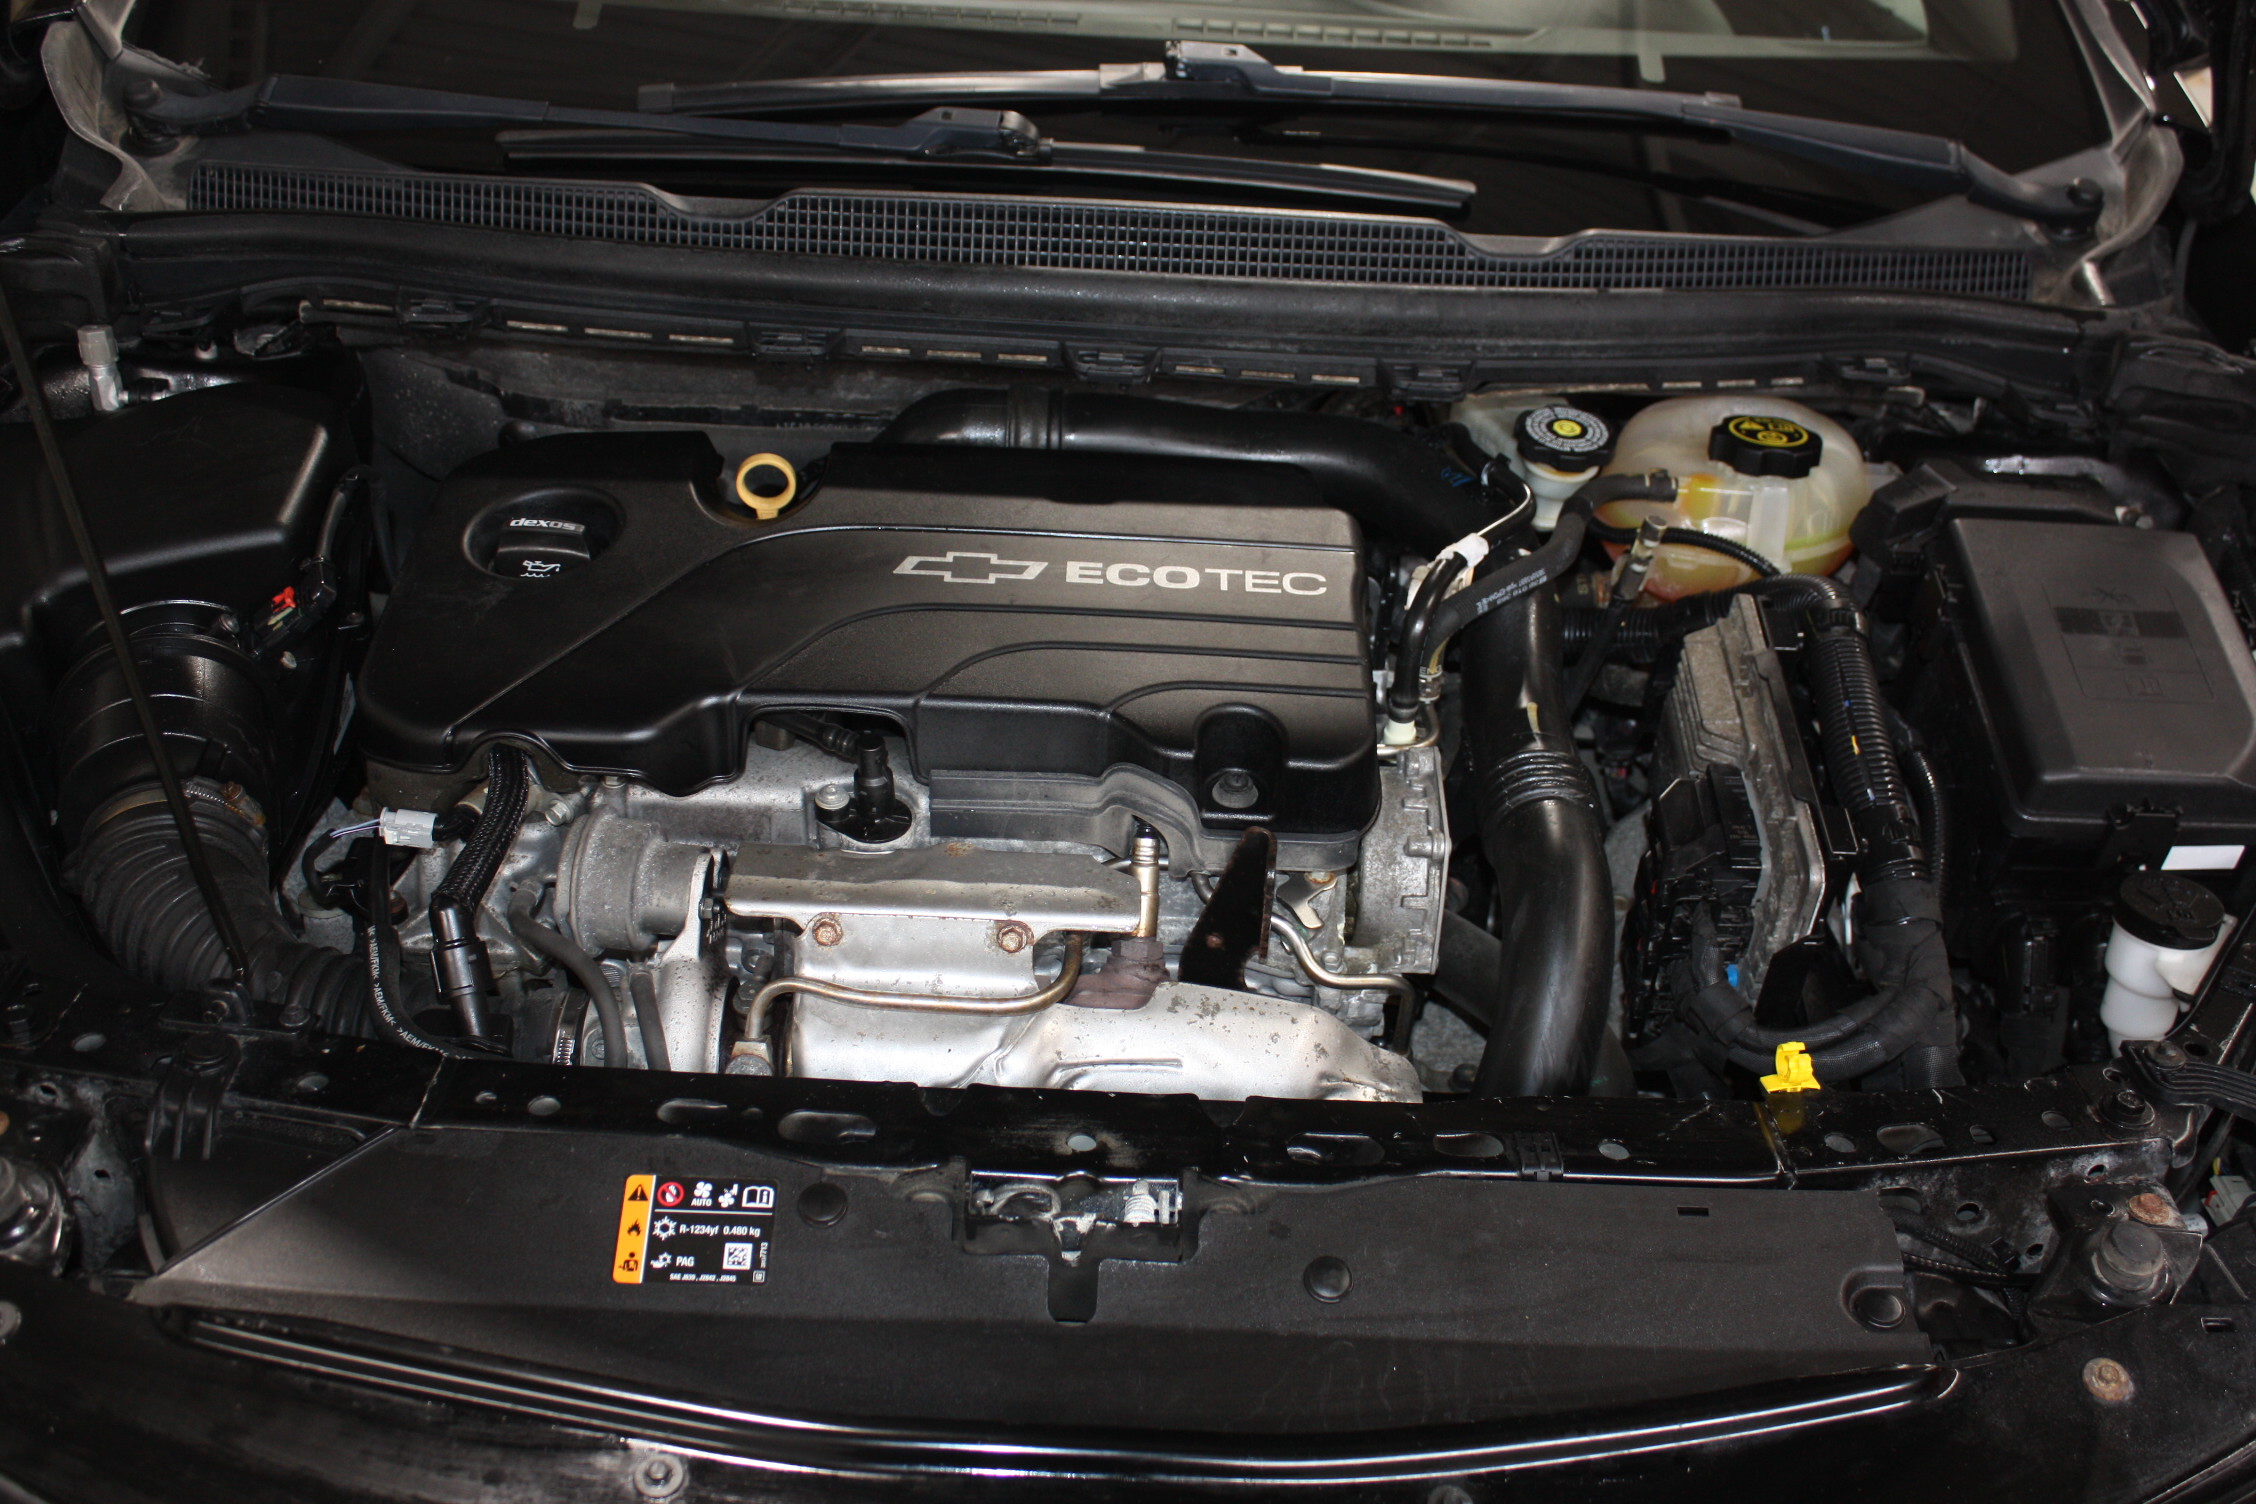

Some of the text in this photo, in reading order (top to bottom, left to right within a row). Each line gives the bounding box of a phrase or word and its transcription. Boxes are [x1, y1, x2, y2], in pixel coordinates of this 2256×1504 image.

[509, 517, 576, 531] dexos
[1065, 561, 1328, 596] ECOTEC
[691, 1198, 712, 1207] AUTO
[679, 1224, 760, 1237] R-1234yf 0.480 kg
[676, 1256, 694, 1267] PAG
